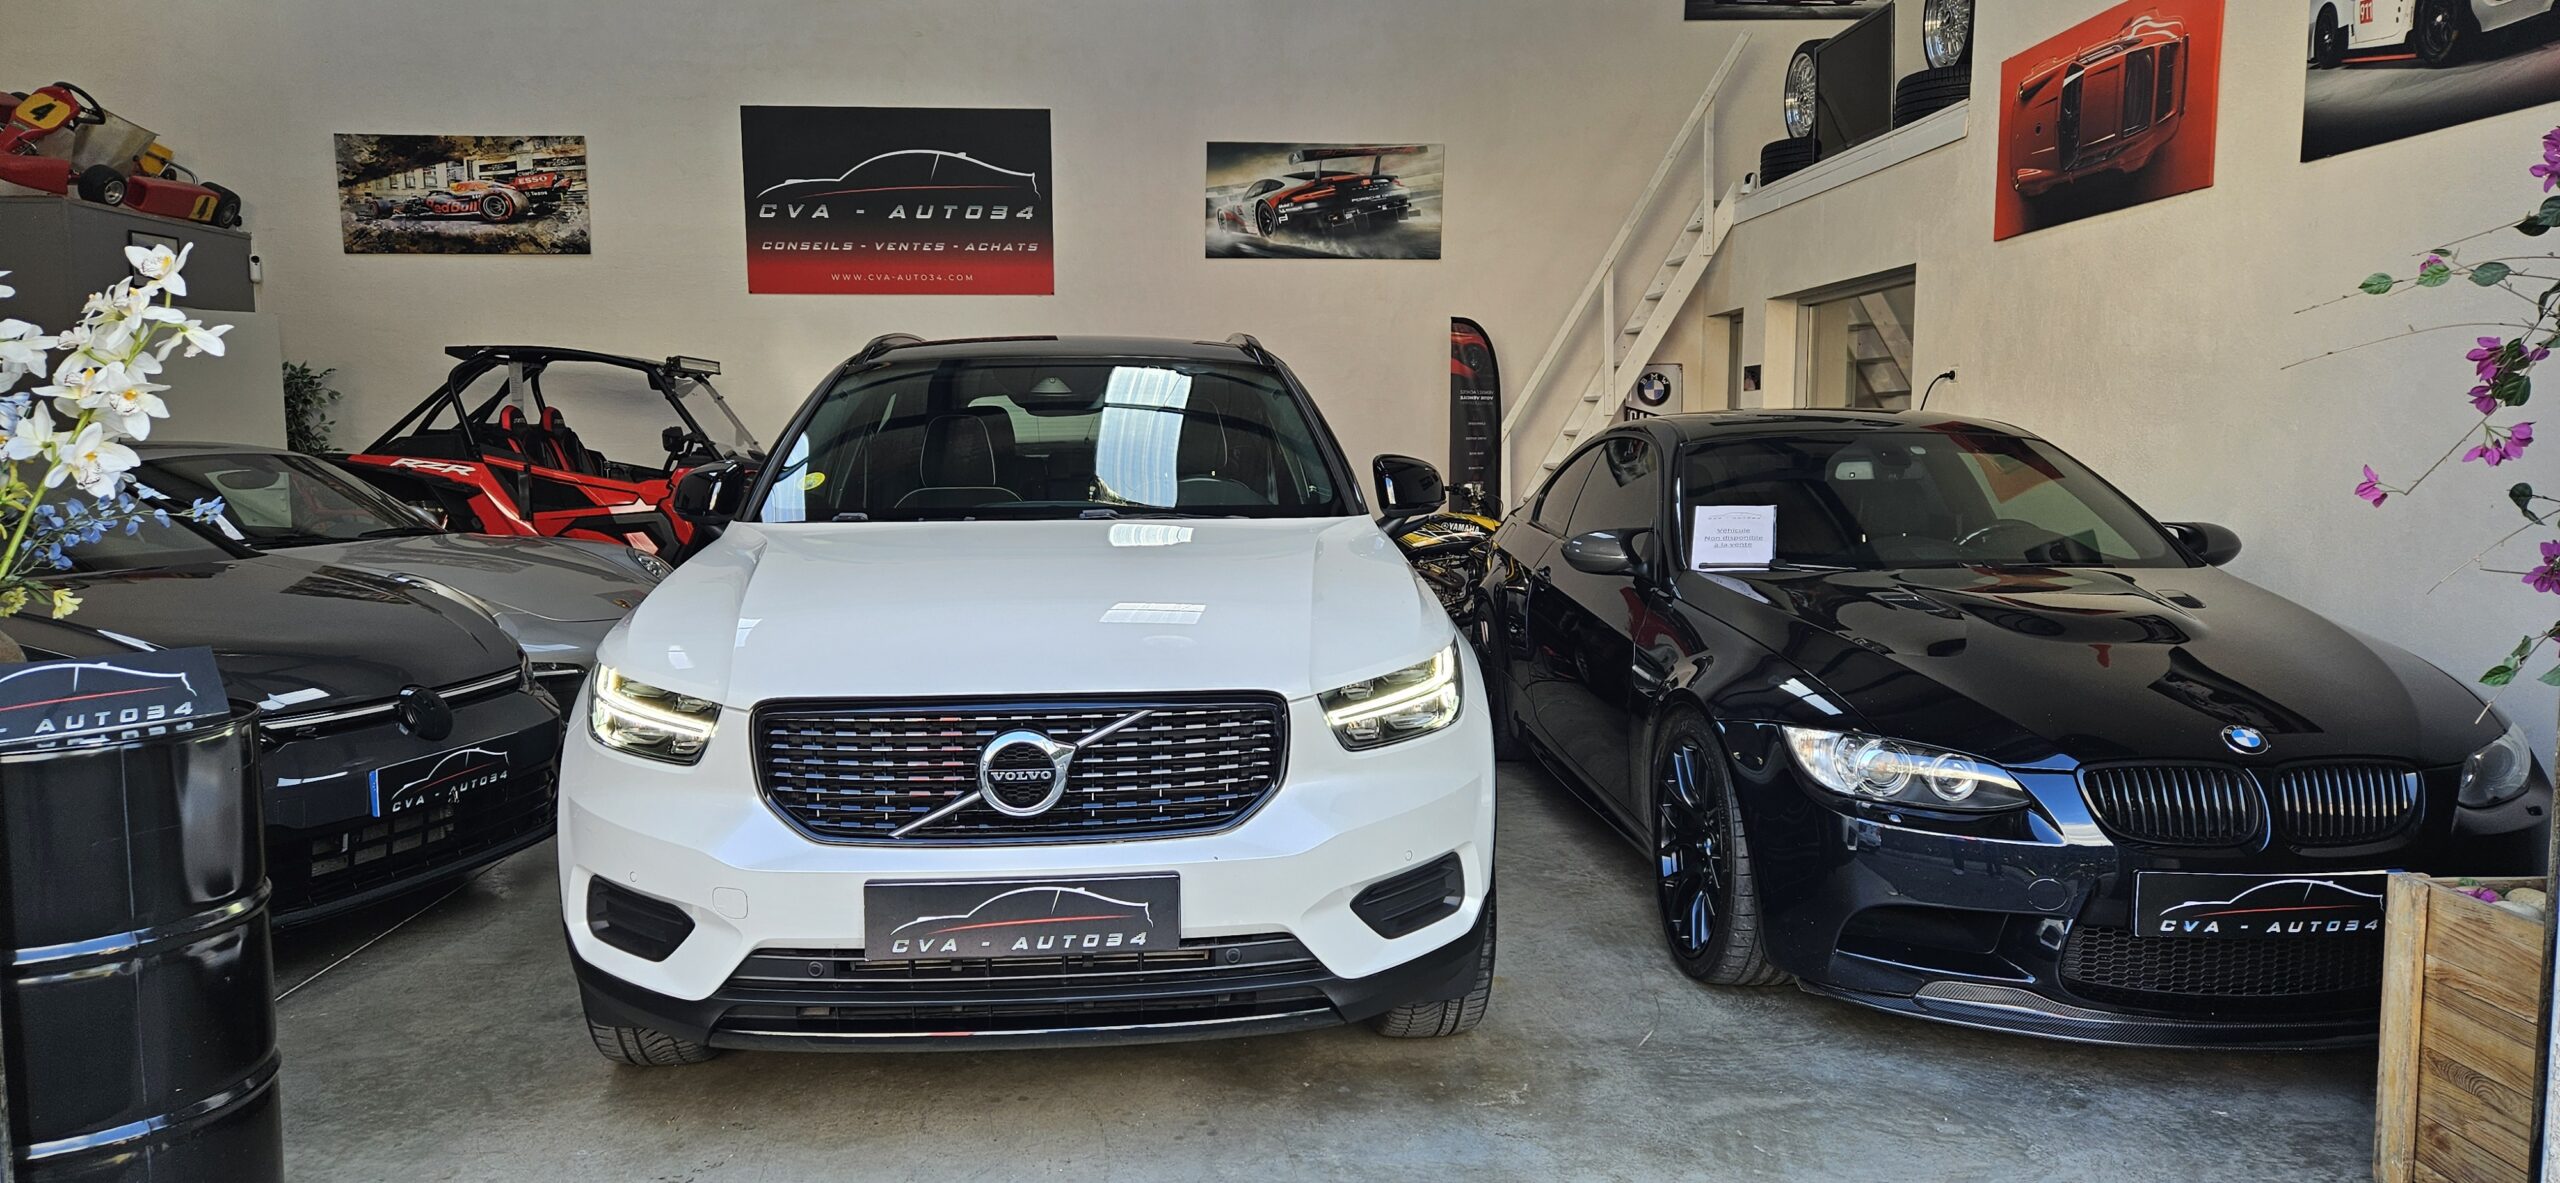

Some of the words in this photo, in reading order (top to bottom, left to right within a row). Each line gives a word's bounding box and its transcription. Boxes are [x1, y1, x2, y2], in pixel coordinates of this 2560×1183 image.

[29, 102, 57, 121] 4
[518, 175, 548, 185] ESSO
[197, 196, 211, 218] 4
[758, 203, 830, 219] CVA
[888, 204, 1034, 220] AUTO34
[761, 240, 854, 251] CONSEILS
[874, 241, 946, 252] VENTES
[963, 242, 1039, 252] ACHATS
[830, 273, 974, 282] WWW.CVA-AUTO34.COM
[389, 457, 476, 476] RZR
[1449, 522, 1480, 533] YAMAHA
[35, 701, 193, 734] AUTO34
[990, 770, 1052, 781] VOLVO
[392, 795, 425, 813] CVA
[2160, 919, 2220, 933] CVA
[2266, 919, 2378, 933] AUTO34
[891, 938, 958, 953] CVA
[1011, 931, 1147, 951] AUTO34
